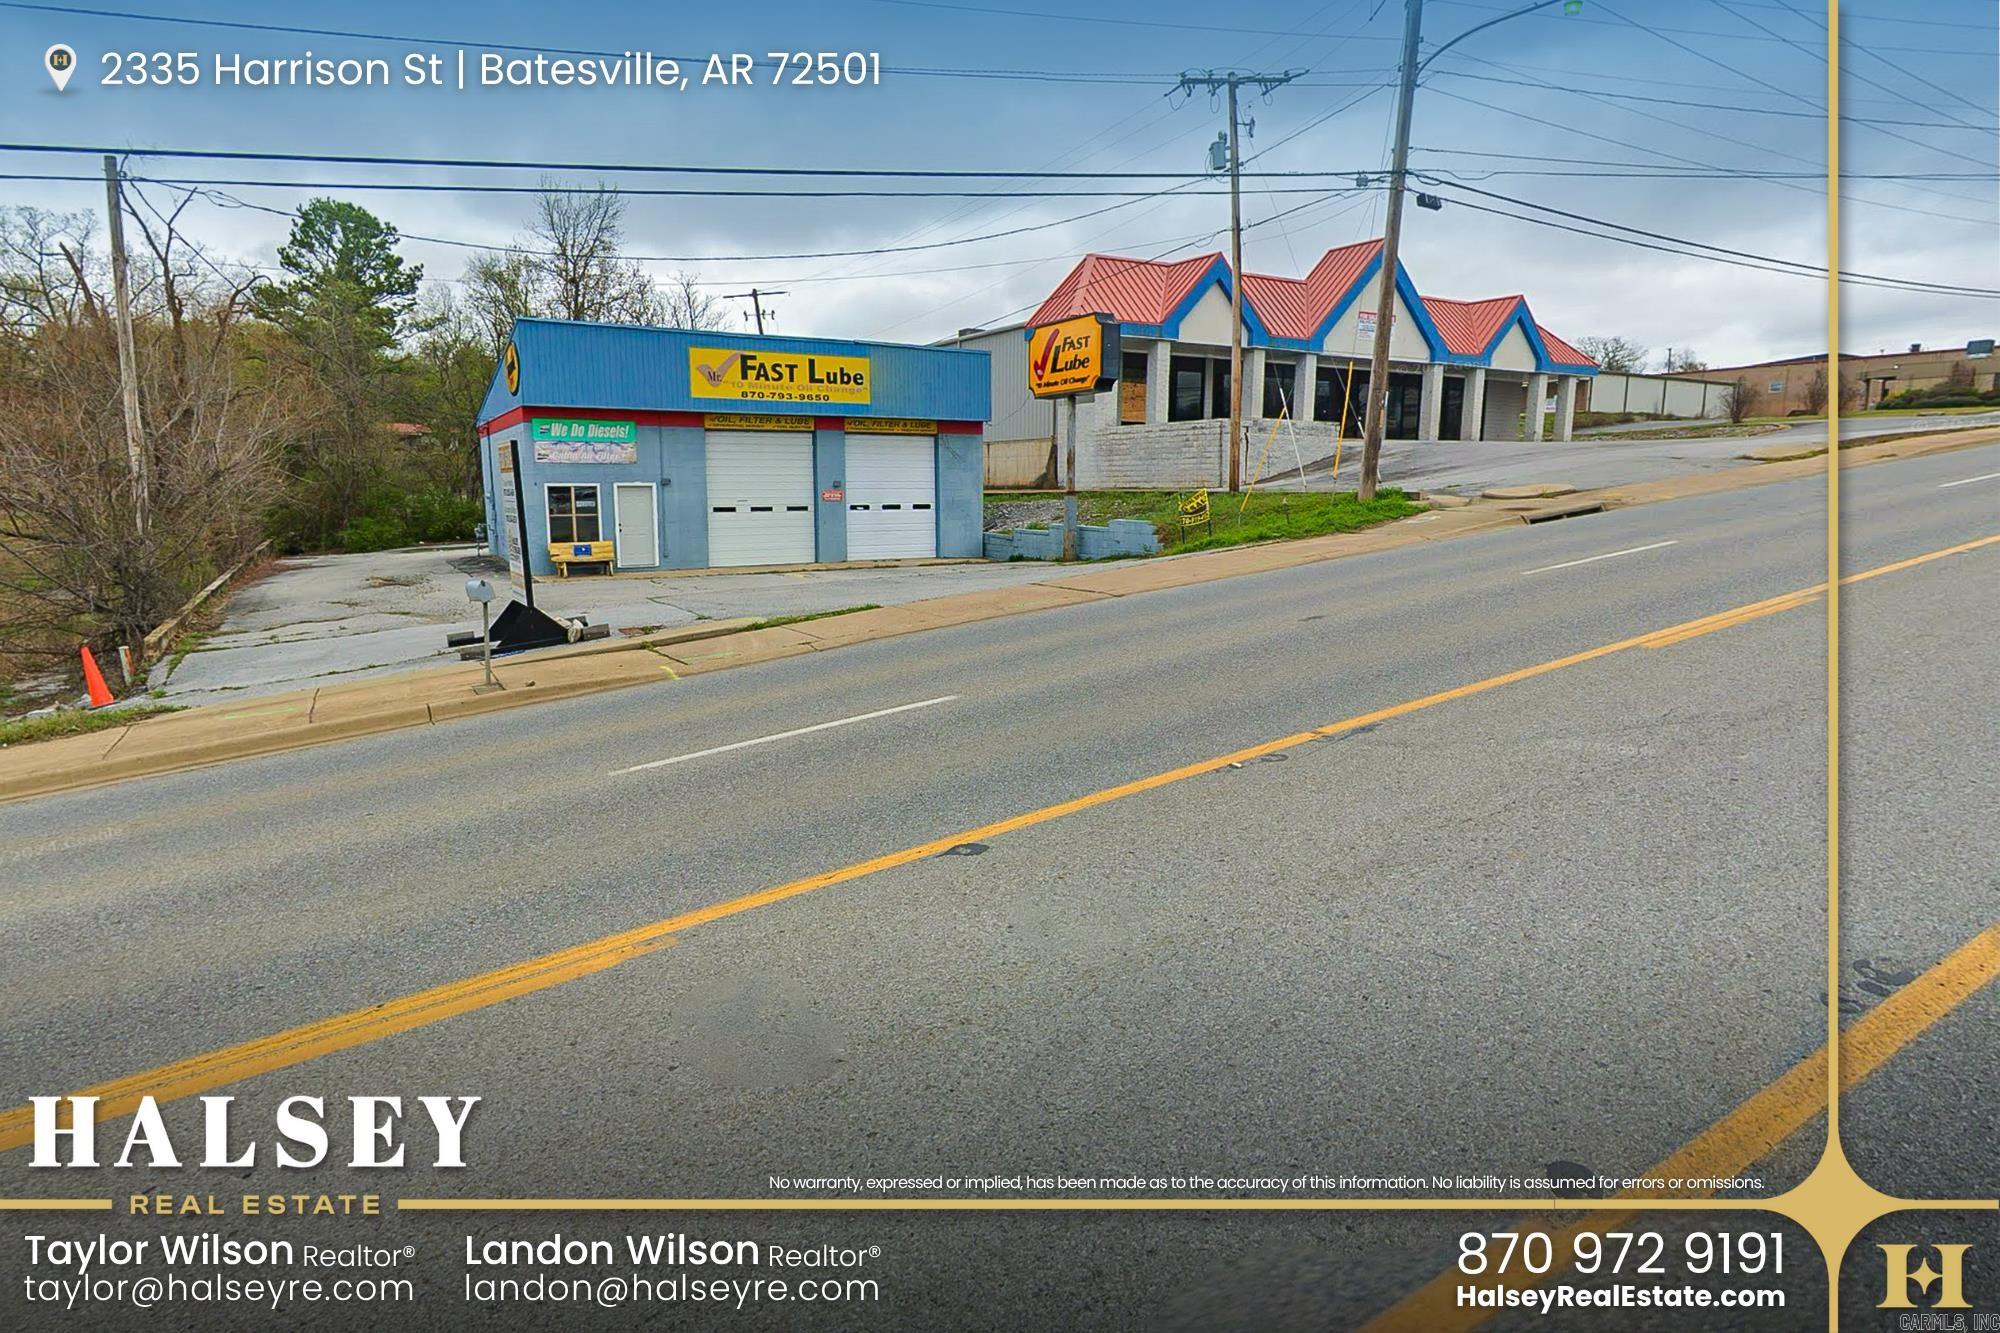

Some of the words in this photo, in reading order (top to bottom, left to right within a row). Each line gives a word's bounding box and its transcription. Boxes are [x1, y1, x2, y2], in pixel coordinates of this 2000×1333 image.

[1062, 335, 1090, 352] FAST
[1050, 345, 1090, 374] Lube
[707, 370, 723, 383] Mr.
[740, 354, 798, 383] FAST
[808, 358, 864, 386] Lube
[748, 381, 793, 392] Minute
[797, 384, 813, 392] Oil
[740, 391, 830, 402] 870-793-9650
[739, 416, 772, 425] FILTER
[784, 416, 810, 425] LUBE
[551, 422, 568, 436] We
[571, 424, 585, 437] Do
[587, 424, 630, 438] Diesels!
